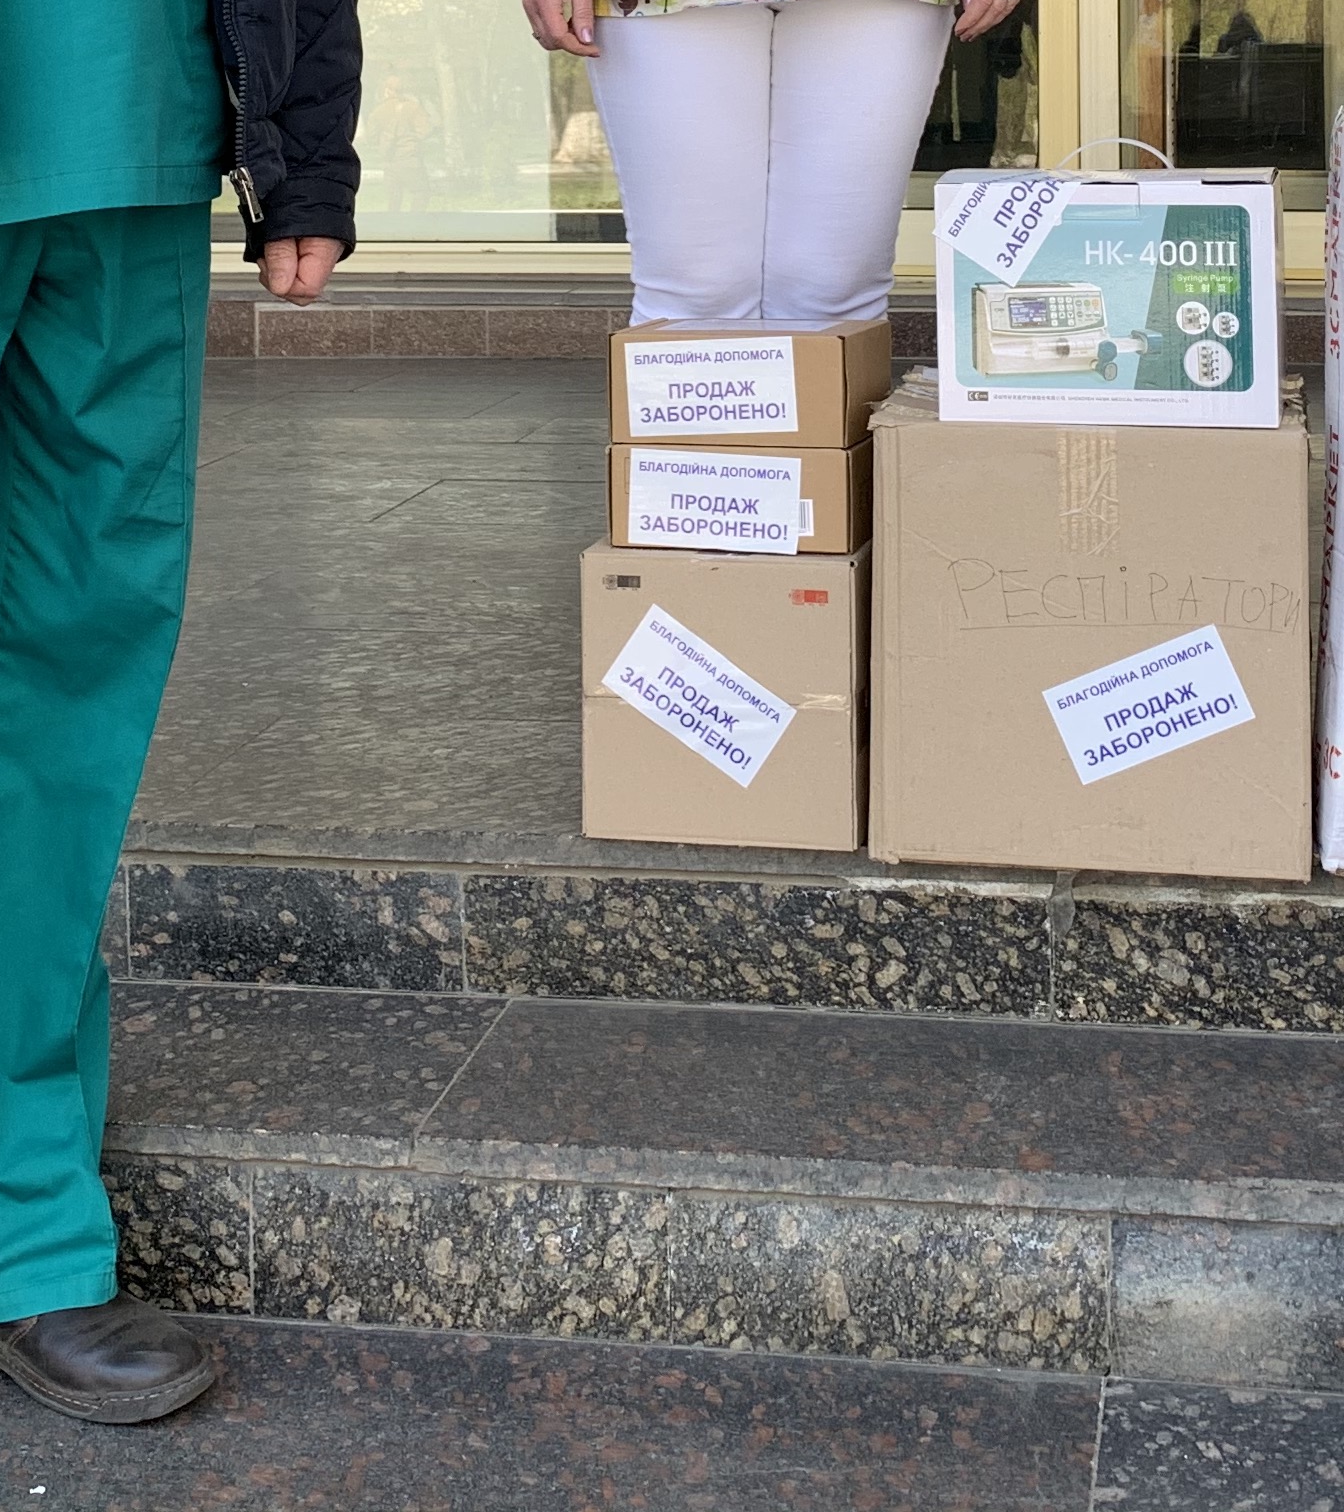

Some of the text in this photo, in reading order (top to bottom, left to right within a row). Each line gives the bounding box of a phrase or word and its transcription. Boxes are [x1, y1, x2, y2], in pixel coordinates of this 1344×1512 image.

[993, 179, 1038, 228] ПРОД
[1176, 273, 1234, 283] Syringe Pump
[634, 349, 785, 366] БЛАГОДІЙНА ДОПОМОГА
[668, 380, 756, 401] ПРОДАЖ
[640, 402, 786, 423] ЗАБОРОНЕНО!
[639, 461, 791, 481] БЛАГОДІЙНА ДОПОМОГА
[670, 493, 760, 516] ПРОДАЖ
[639, 515, 789, 541] ЗАБОРОНЕНО!
[649, 619, 782, 724] БЛАГОДІЙНА ДОПОМОГА
[1056, 640, 1215, 710] БЛАГОДІЙНА ДОПОМОГА
[657, 665, 740, 733] ПРОДАЖ
[1103, 681, 1199, 732] ПРОДАЖ
[619, 666, 752, 770] ЗАБОРОНЕНО!
[1083, 693, 1239, 767] ЗАБОРОНЕНО!
